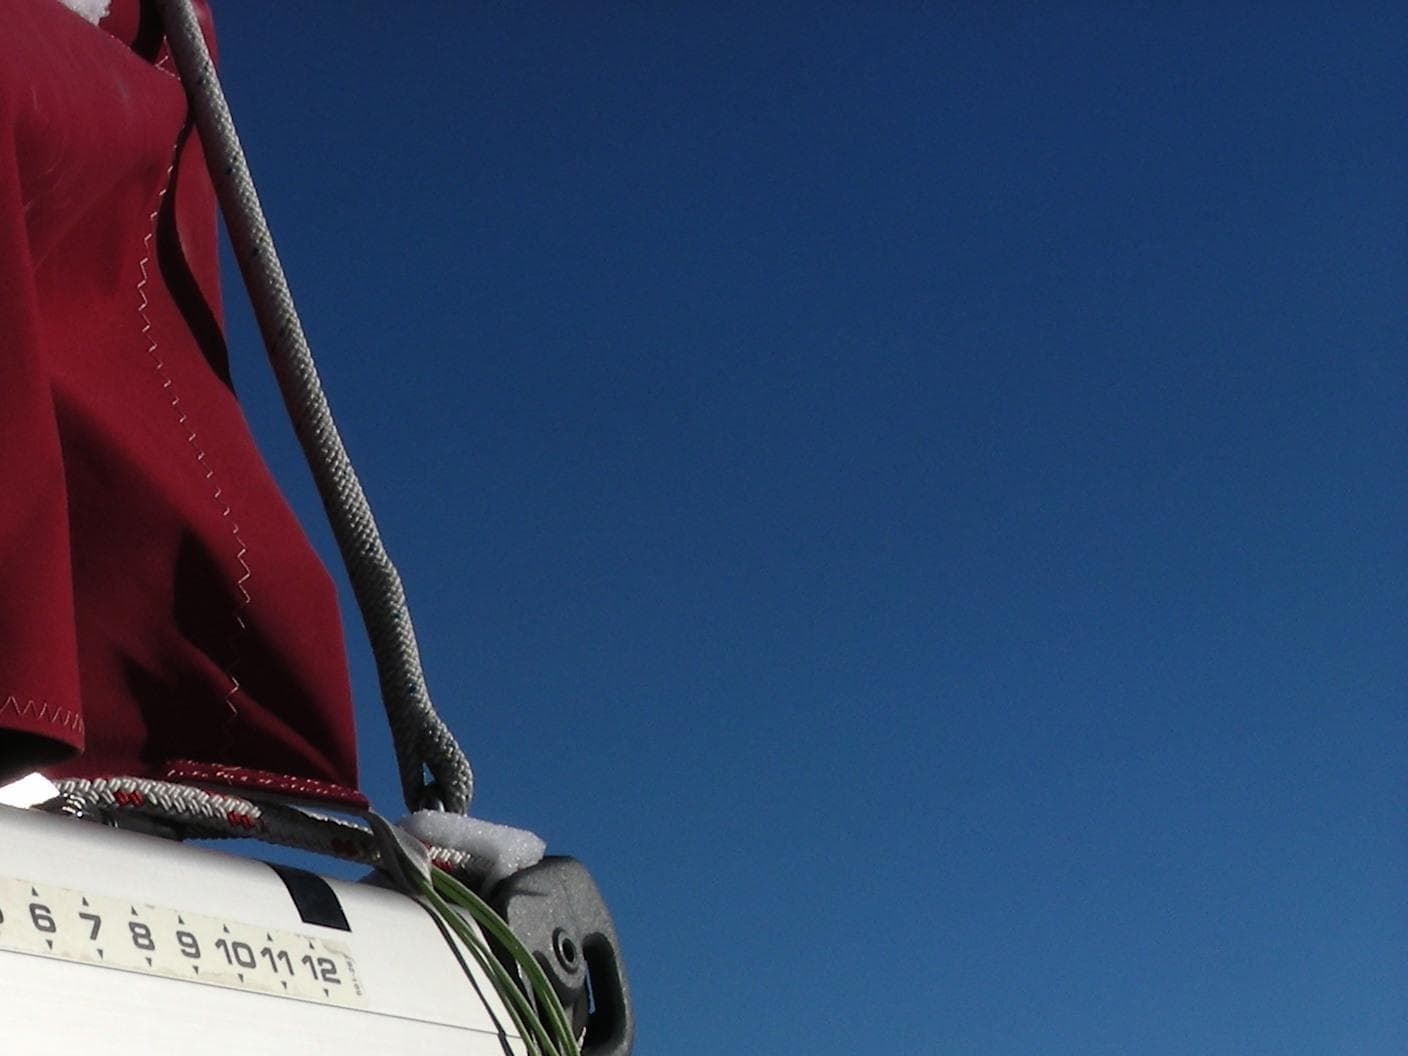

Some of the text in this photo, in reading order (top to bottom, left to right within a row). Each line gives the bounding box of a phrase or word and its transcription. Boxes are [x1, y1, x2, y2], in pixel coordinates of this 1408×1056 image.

[28, 903, 57, 933] 6
[78, 911, 102, 941] 7
[128, 921, 156, 951] 8
[176, 930, 201, 959] 9
[215, 938, 257, 969] 10
[260, 946, 295, 976] 11
[301, 955, 341, 984] 12
